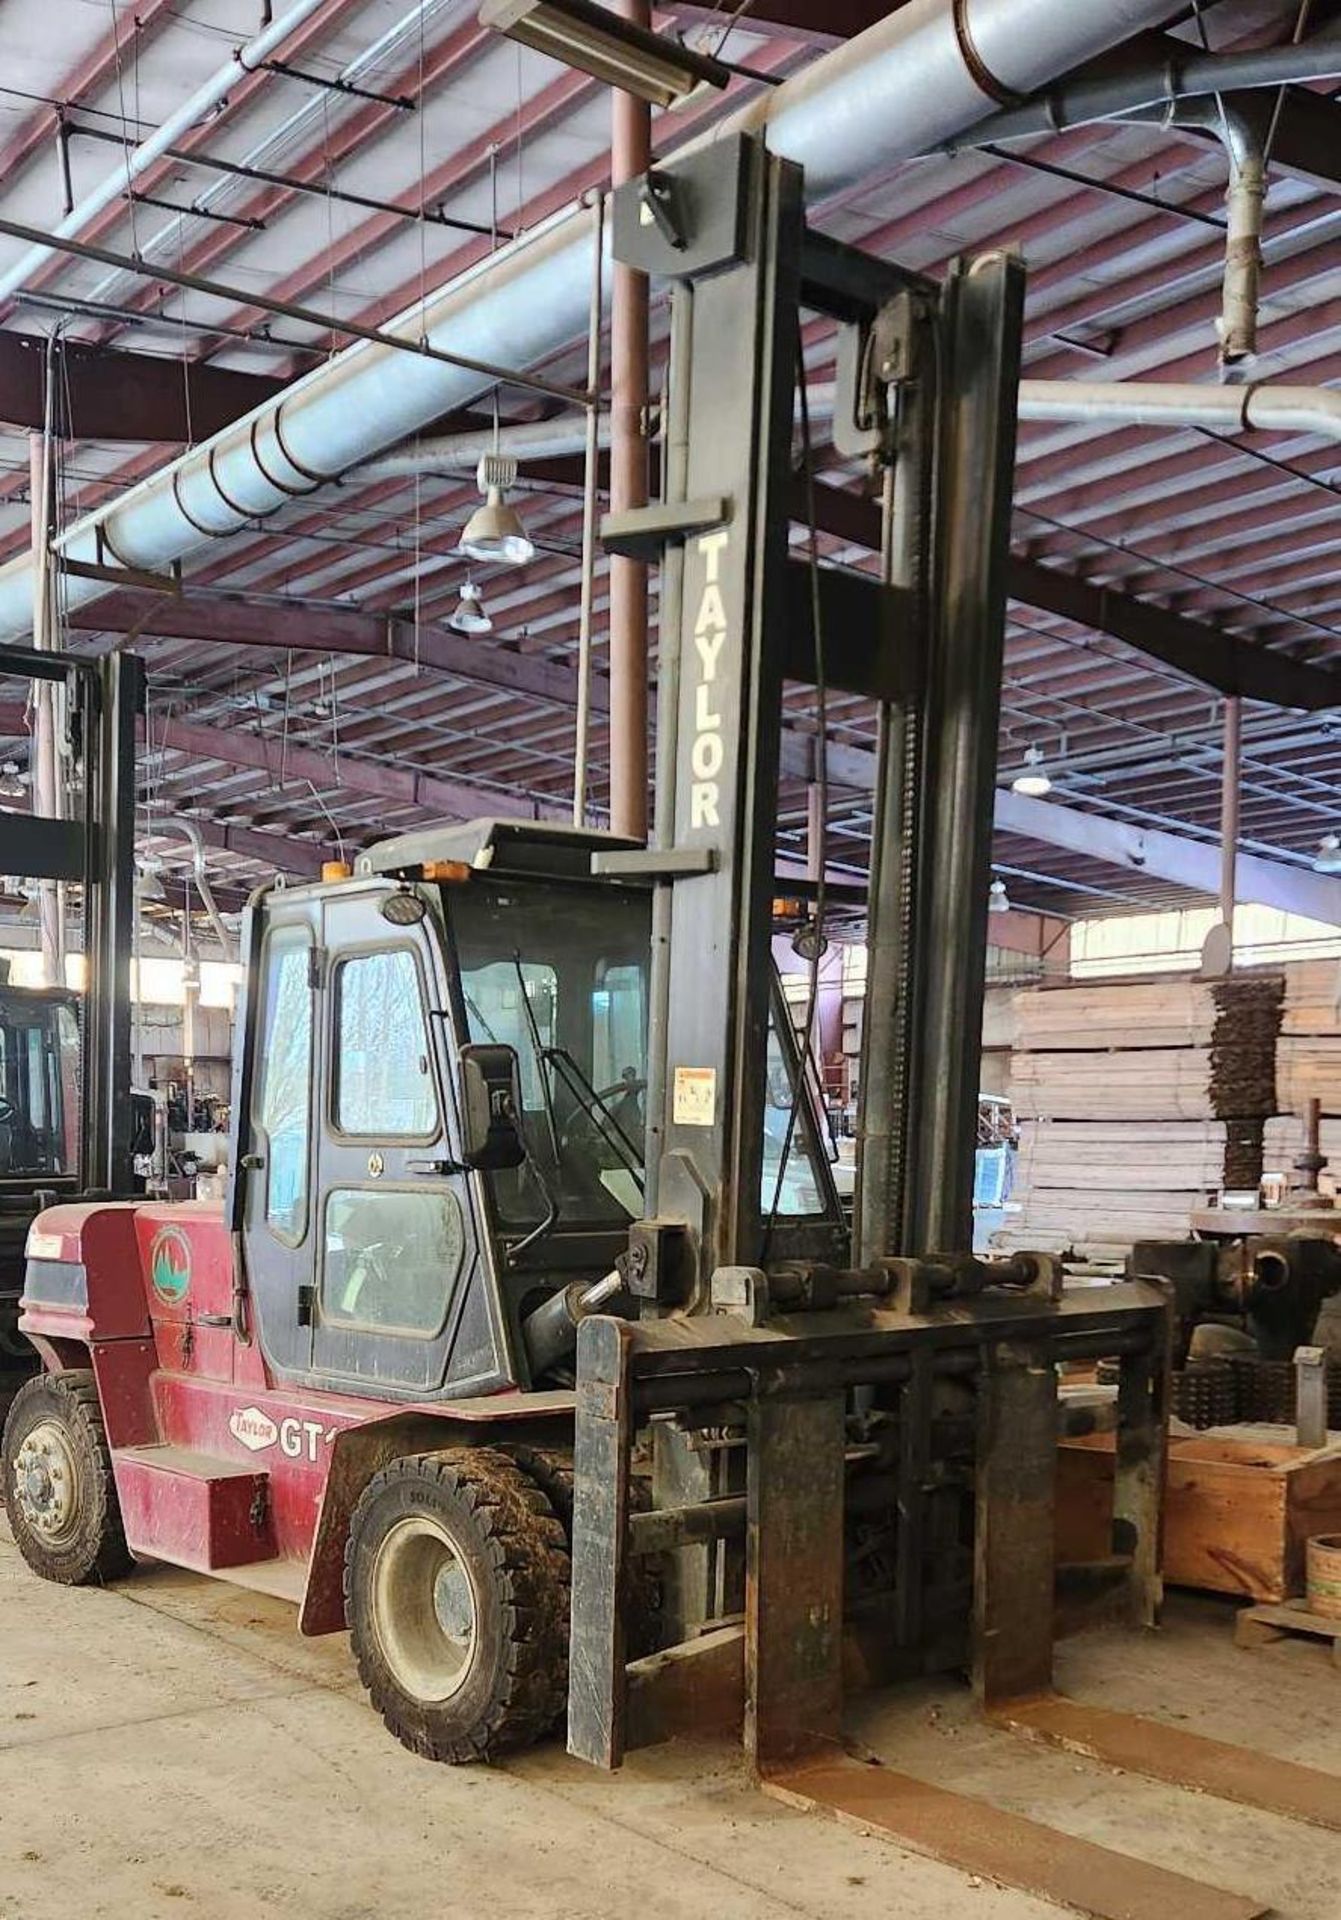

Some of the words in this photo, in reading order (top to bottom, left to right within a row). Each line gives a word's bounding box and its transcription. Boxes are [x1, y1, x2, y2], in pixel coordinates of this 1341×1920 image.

[691, 531, 729, 829] TAYLOR
[234, 1409, 274, 1440] TAYLOR
[280, 1418, 338, 1462] GT
